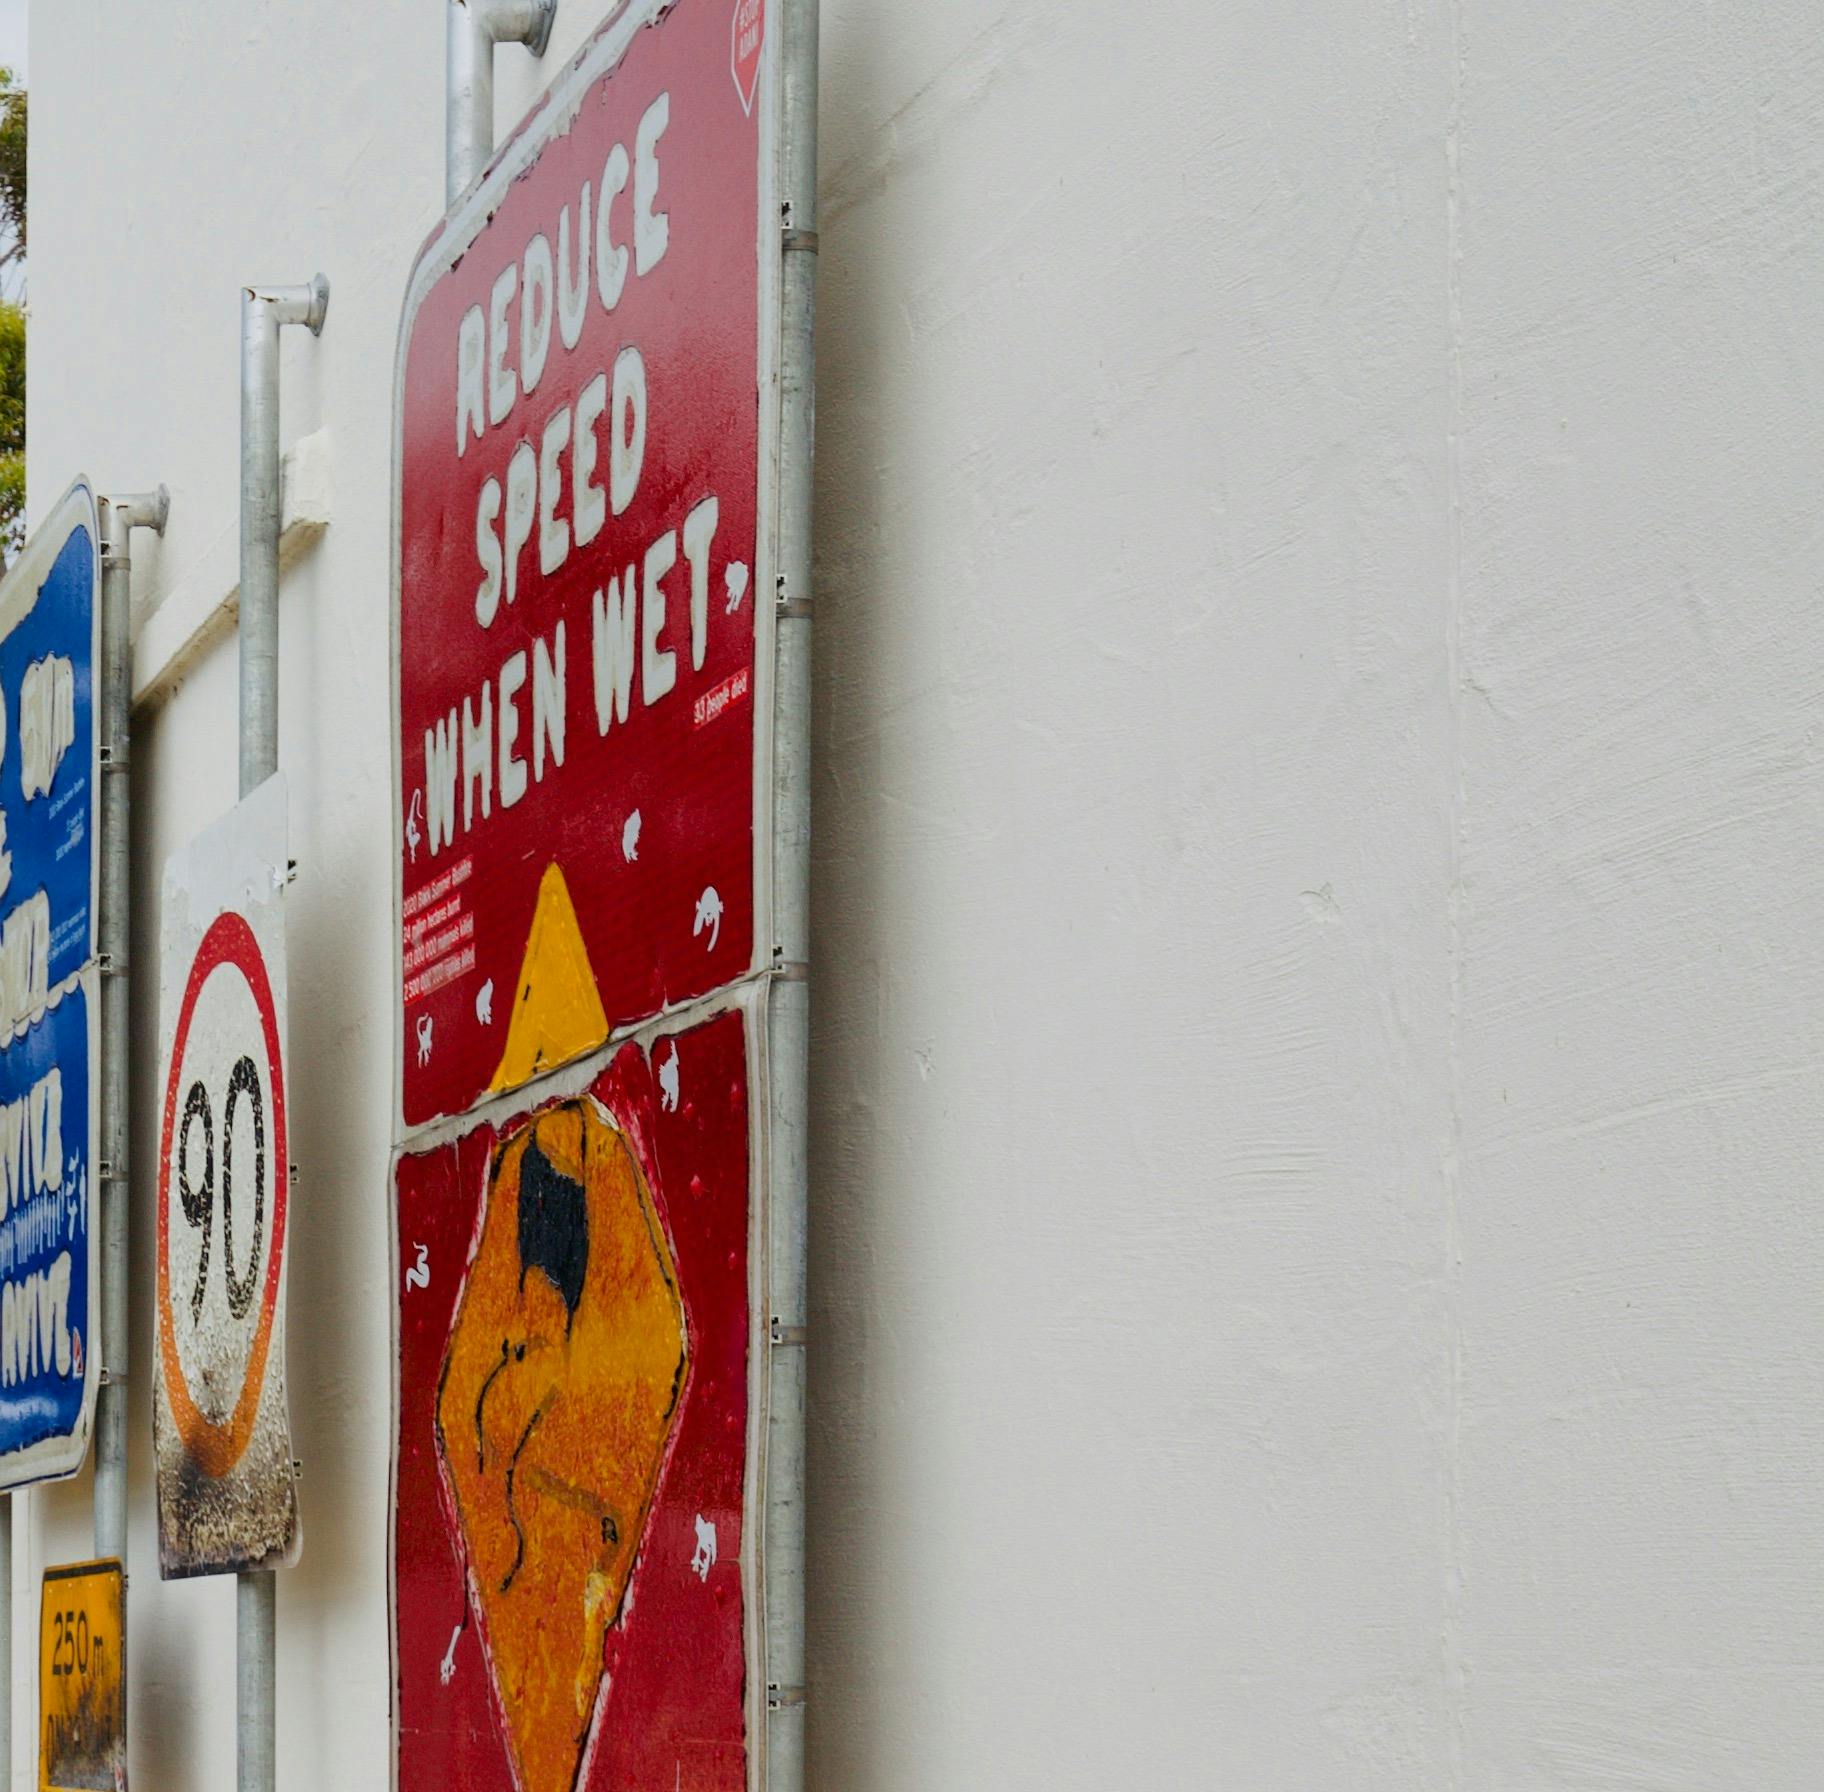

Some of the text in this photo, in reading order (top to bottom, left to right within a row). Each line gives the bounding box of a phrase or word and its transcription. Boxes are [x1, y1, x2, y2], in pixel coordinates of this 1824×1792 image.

[456, 91, 670, 457] REDUCE
[476, 345, 647, 629] SPEED
[425, 495, 719, 856] WHEN WET
[179, 1055, 264, 1327] 90
[53, 1610, 104, 1678] 250 m
